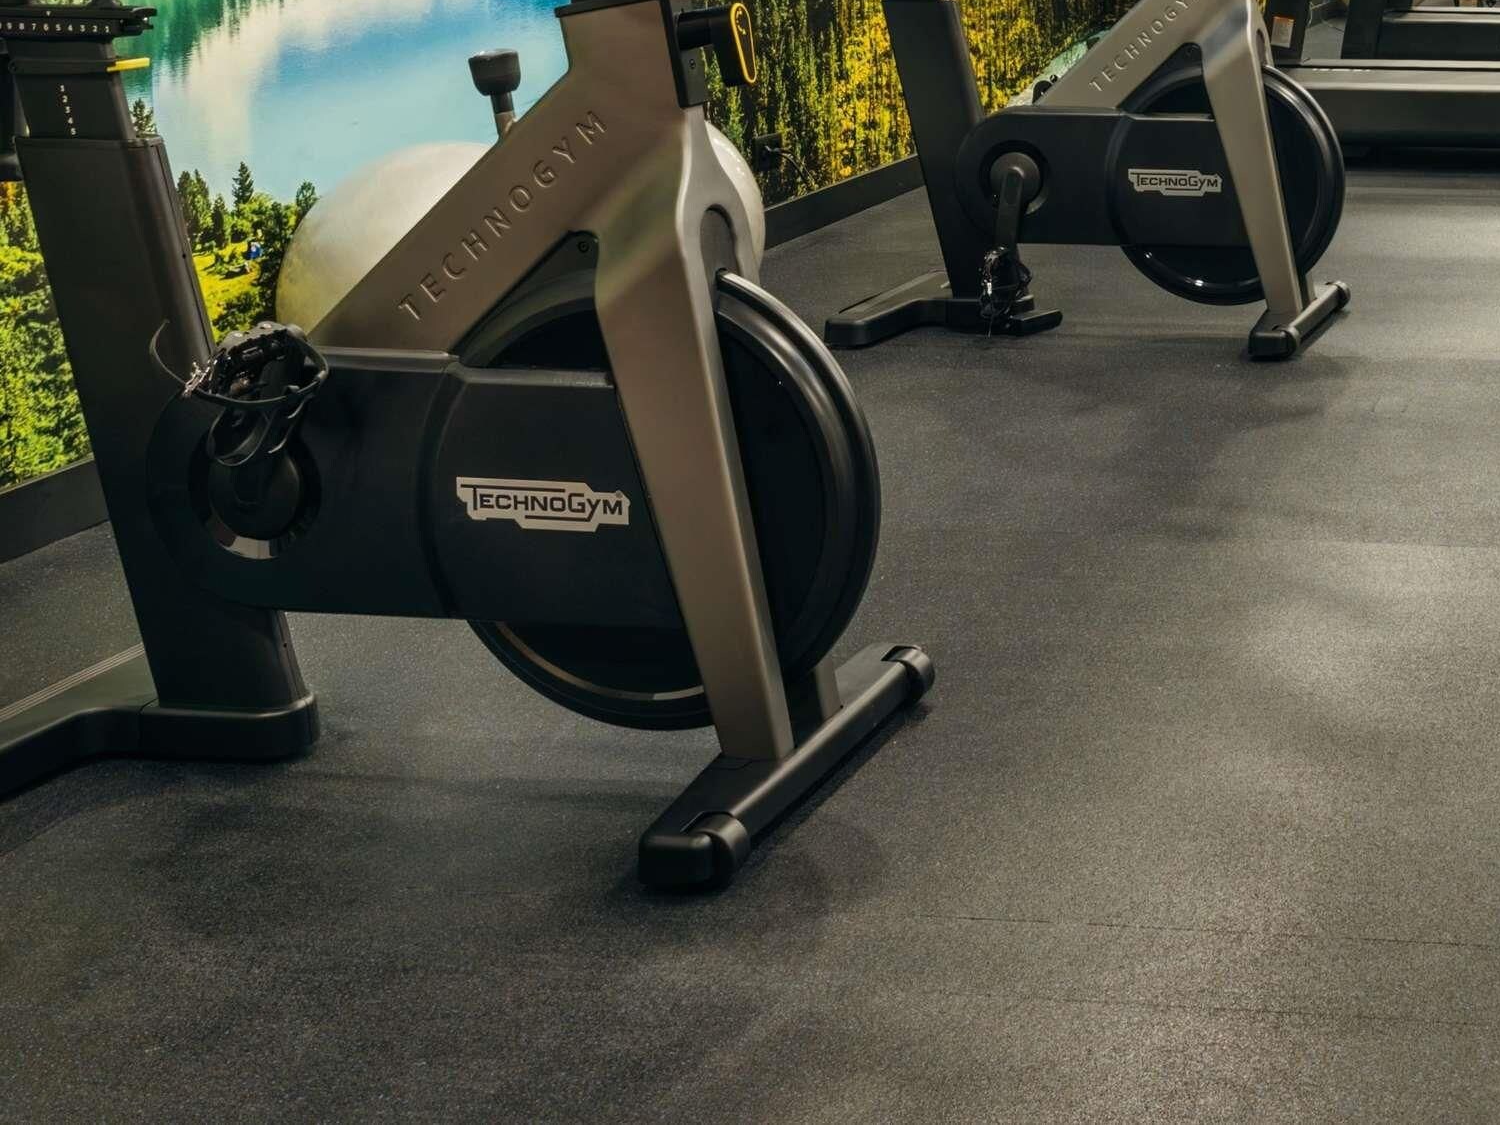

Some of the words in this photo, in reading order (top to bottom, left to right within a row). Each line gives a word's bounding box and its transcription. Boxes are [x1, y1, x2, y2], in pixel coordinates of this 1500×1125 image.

[1130, 172, 1218, 191] TECHNOGYM
[398, 110, 608, 321] TECHNOGYM
[460, 483, 623, 522] TECHNOGYM
